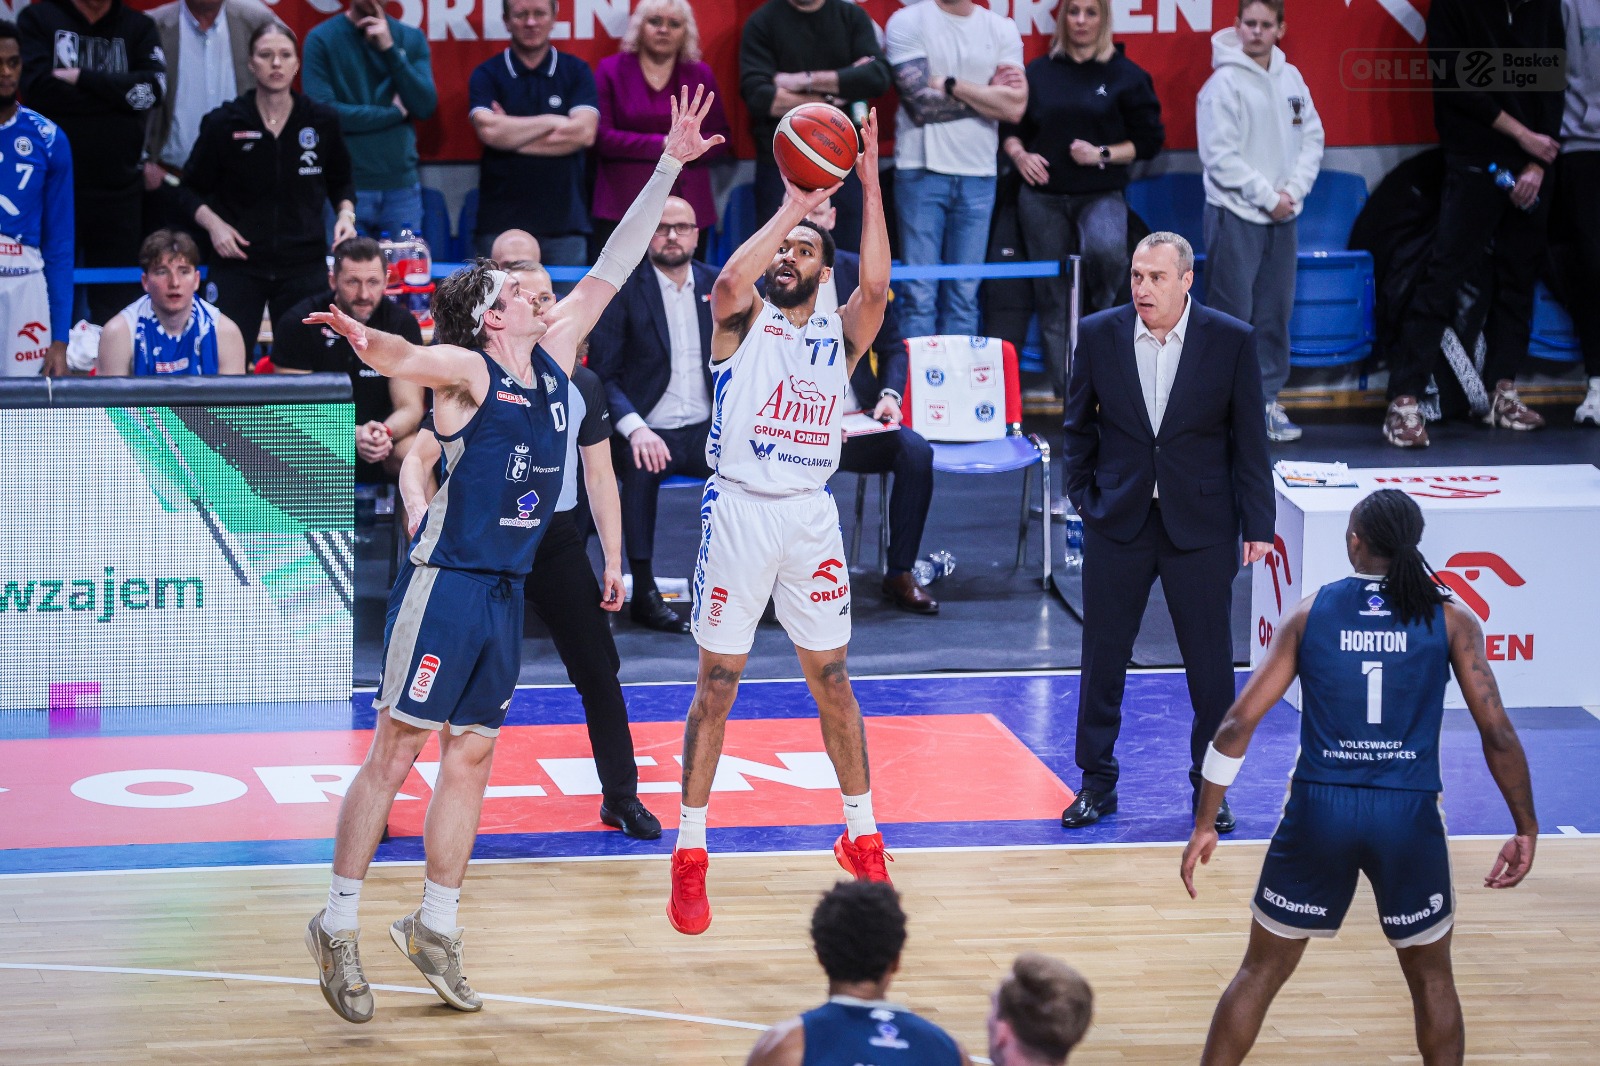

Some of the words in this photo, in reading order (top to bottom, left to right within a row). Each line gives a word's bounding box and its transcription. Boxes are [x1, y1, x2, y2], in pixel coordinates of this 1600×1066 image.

[805, 337, 839, 366] 77
[756, 380, 836, 426] Anwil
[754, 425, 792, 440] GRUPA
[796, 432, 829, 445] ORLEN
[810, 583, 848, 602] ORLEN
[1339, 630, 1407, 652] HORTON
[1361, 661, 1383, 724] 1
[1323, 749, 1374, 761] FINANCIAL
[1275, 894, 1328, 917] Dantex
[1383, 907, 1430, 926] netuno
